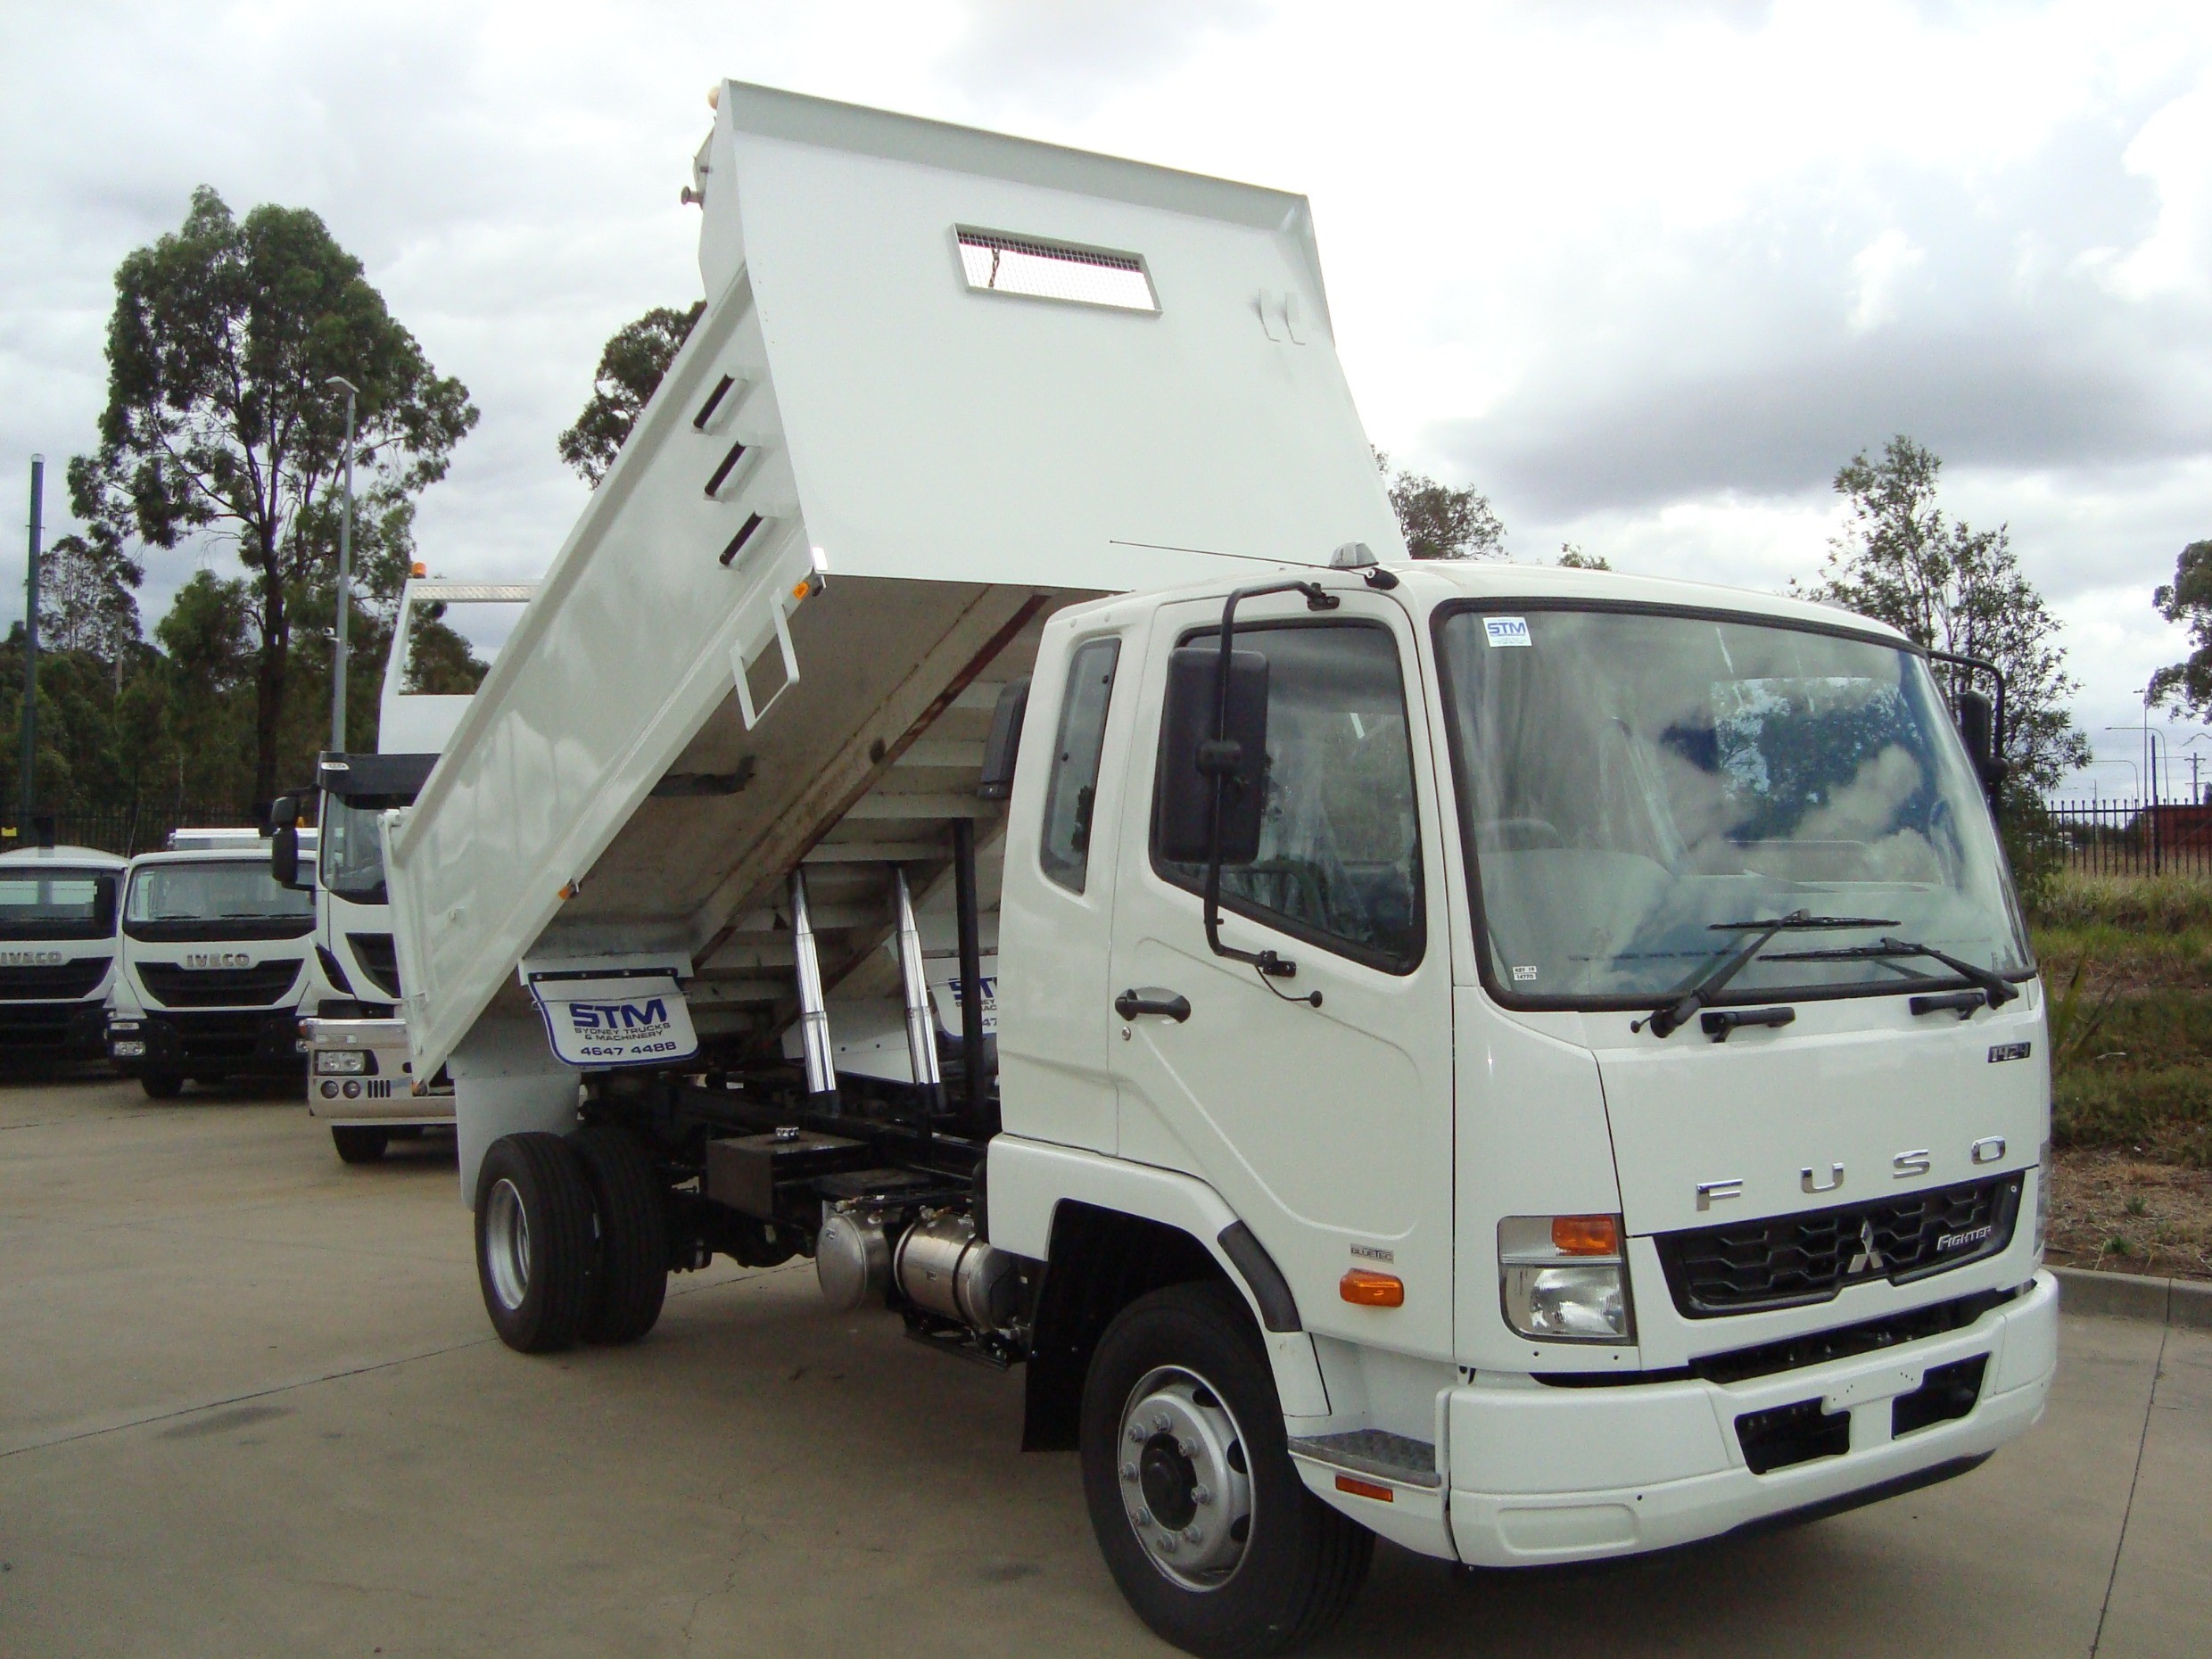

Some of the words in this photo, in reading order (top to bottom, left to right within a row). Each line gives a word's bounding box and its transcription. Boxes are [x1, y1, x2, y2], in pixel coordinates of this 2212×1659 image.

[1487, 622, 1526, 633] STM
[1, 951, 62, 964] IVECO
[186, 953, 250, 967] IVECO
[948, 977, 997, 1000] ST
[569, 998, 668, 1028] STM
[574, 1027, 620, 1035] SYDNEY
[623, 1022, 671, 1034] TRUCKS
[595, 1029, 663, 1041] MACHINERY
[581, 1046, 624, 1056] 4647
[631, 1041, 677, 1054] 4488
[1696, 1135, 2006, 1211] FUSO
